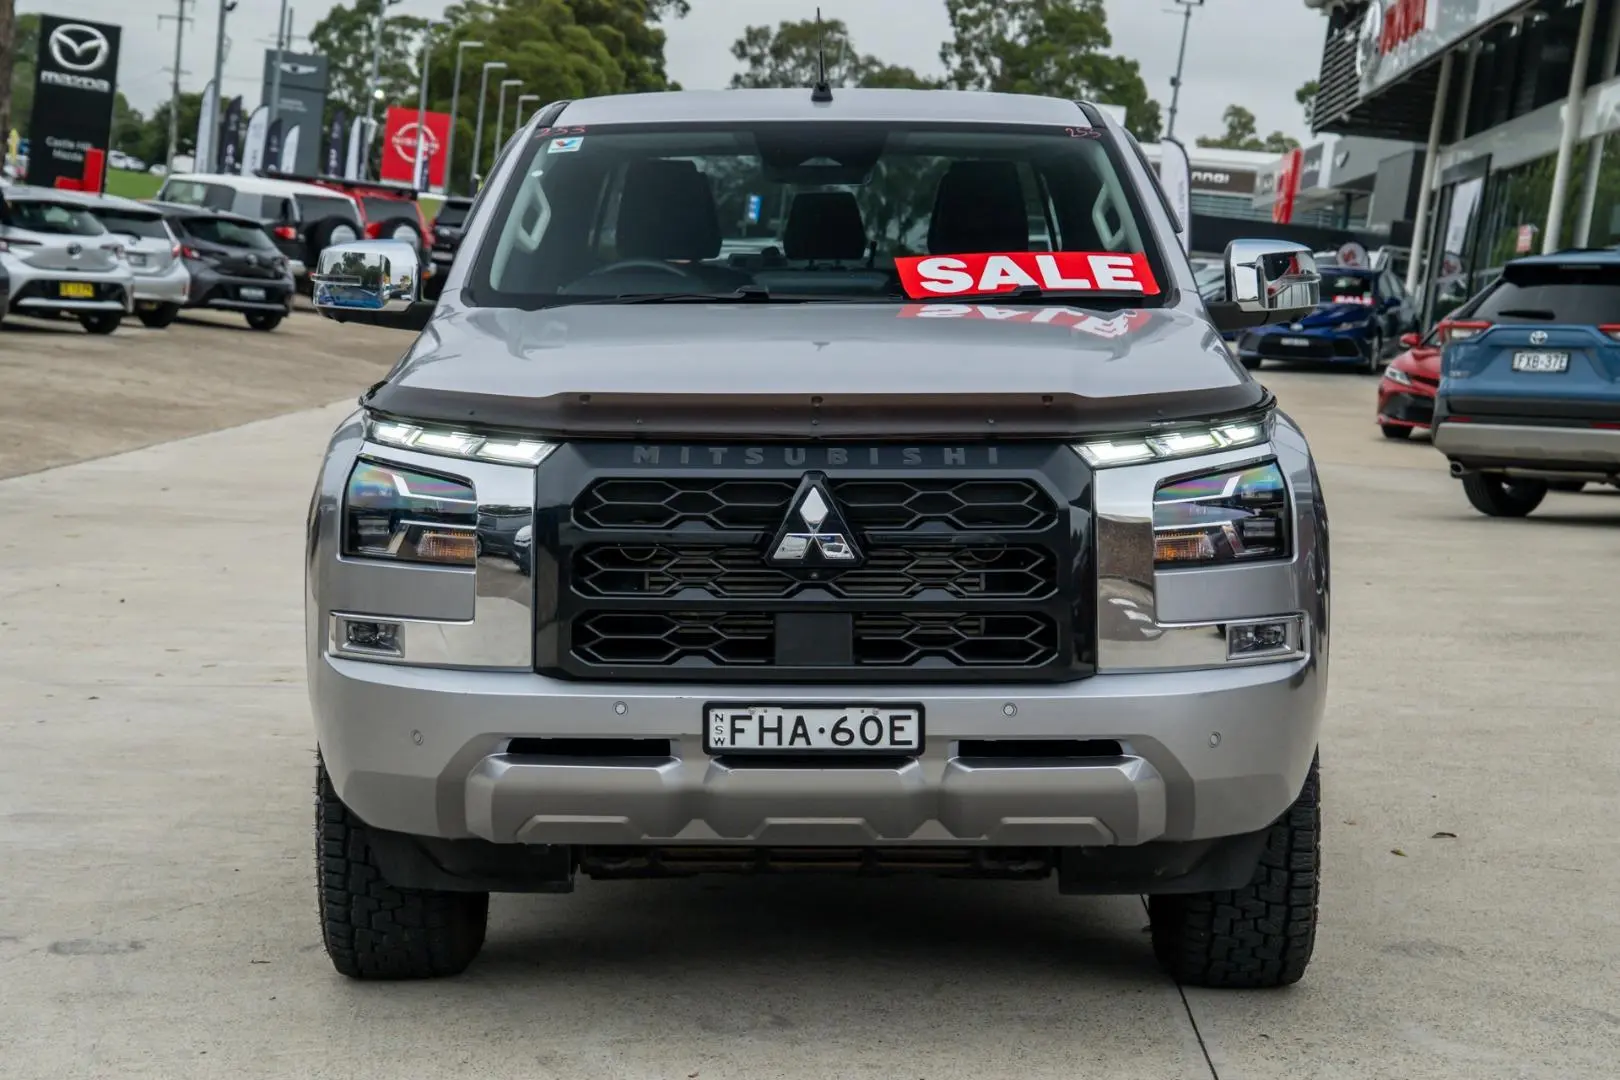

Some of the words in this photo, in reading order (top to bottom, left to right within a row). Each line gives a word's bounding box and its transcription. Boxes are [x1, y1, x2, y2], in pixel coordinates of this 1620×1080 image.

[41, 70, 110, 93] mazda
[917, 255, 1143, 293] SALE
[633, 446, 999, 465] MITSUBISHI
